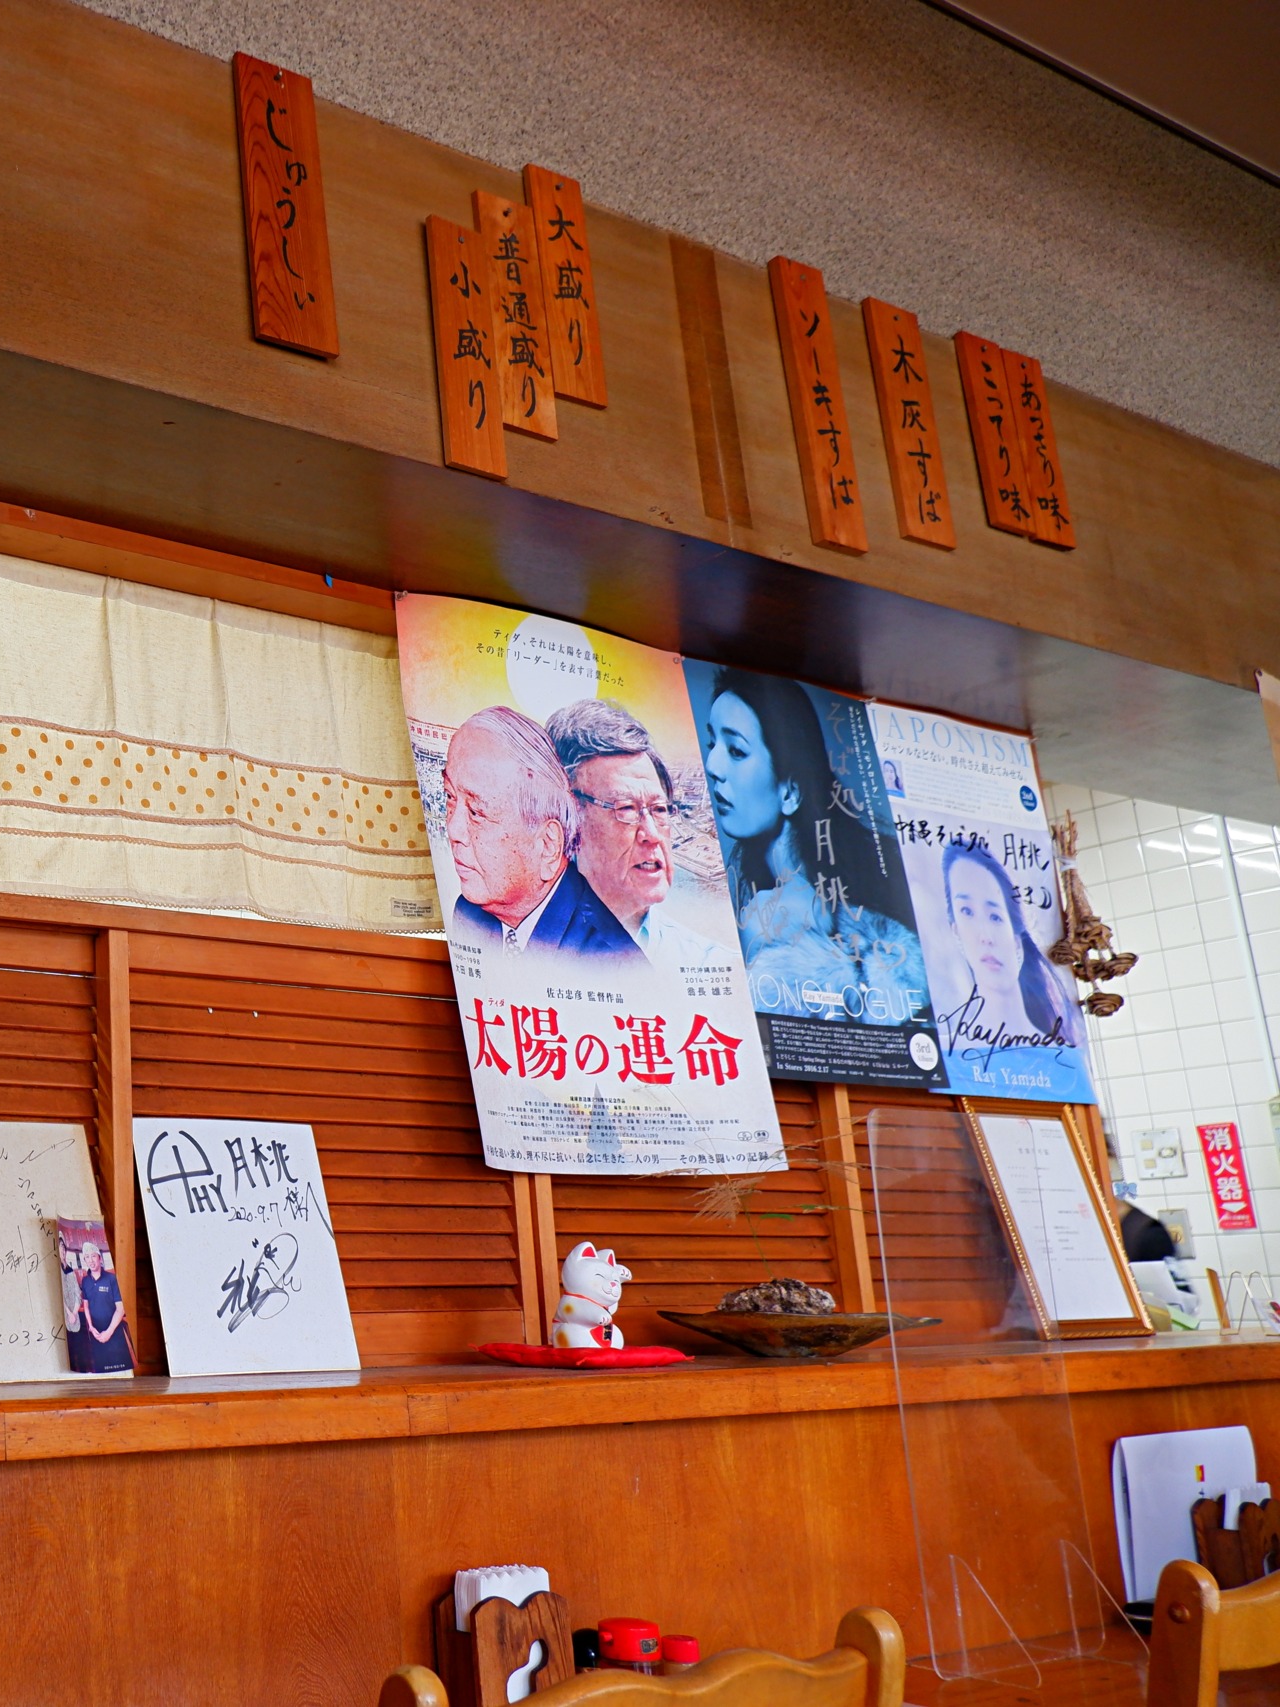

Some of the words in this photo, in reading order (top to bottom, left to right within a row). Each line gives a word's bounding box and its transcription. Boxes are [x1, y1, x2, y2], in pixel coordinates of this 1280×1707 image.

[493, 233, 545, 418] 普通盛り
[548, 205, 589, 366] 大盛り
[450, 261, 491, 430] 小盛り
[892, 335, 942, 525] 木灰すば
[870, 708, 1031, 768] JAPONISM
[1003, 833, 1050, 871] 月桃
[464, 997, 744, 1087] 太陽の運命
[972, 1066, 997, 1088] Ray
[1000, 1068, 1051, 1088] Yamada
[224, 1137, 299, 1198] 月桃
[1205, 1127, 1243, 1201] 消火器
